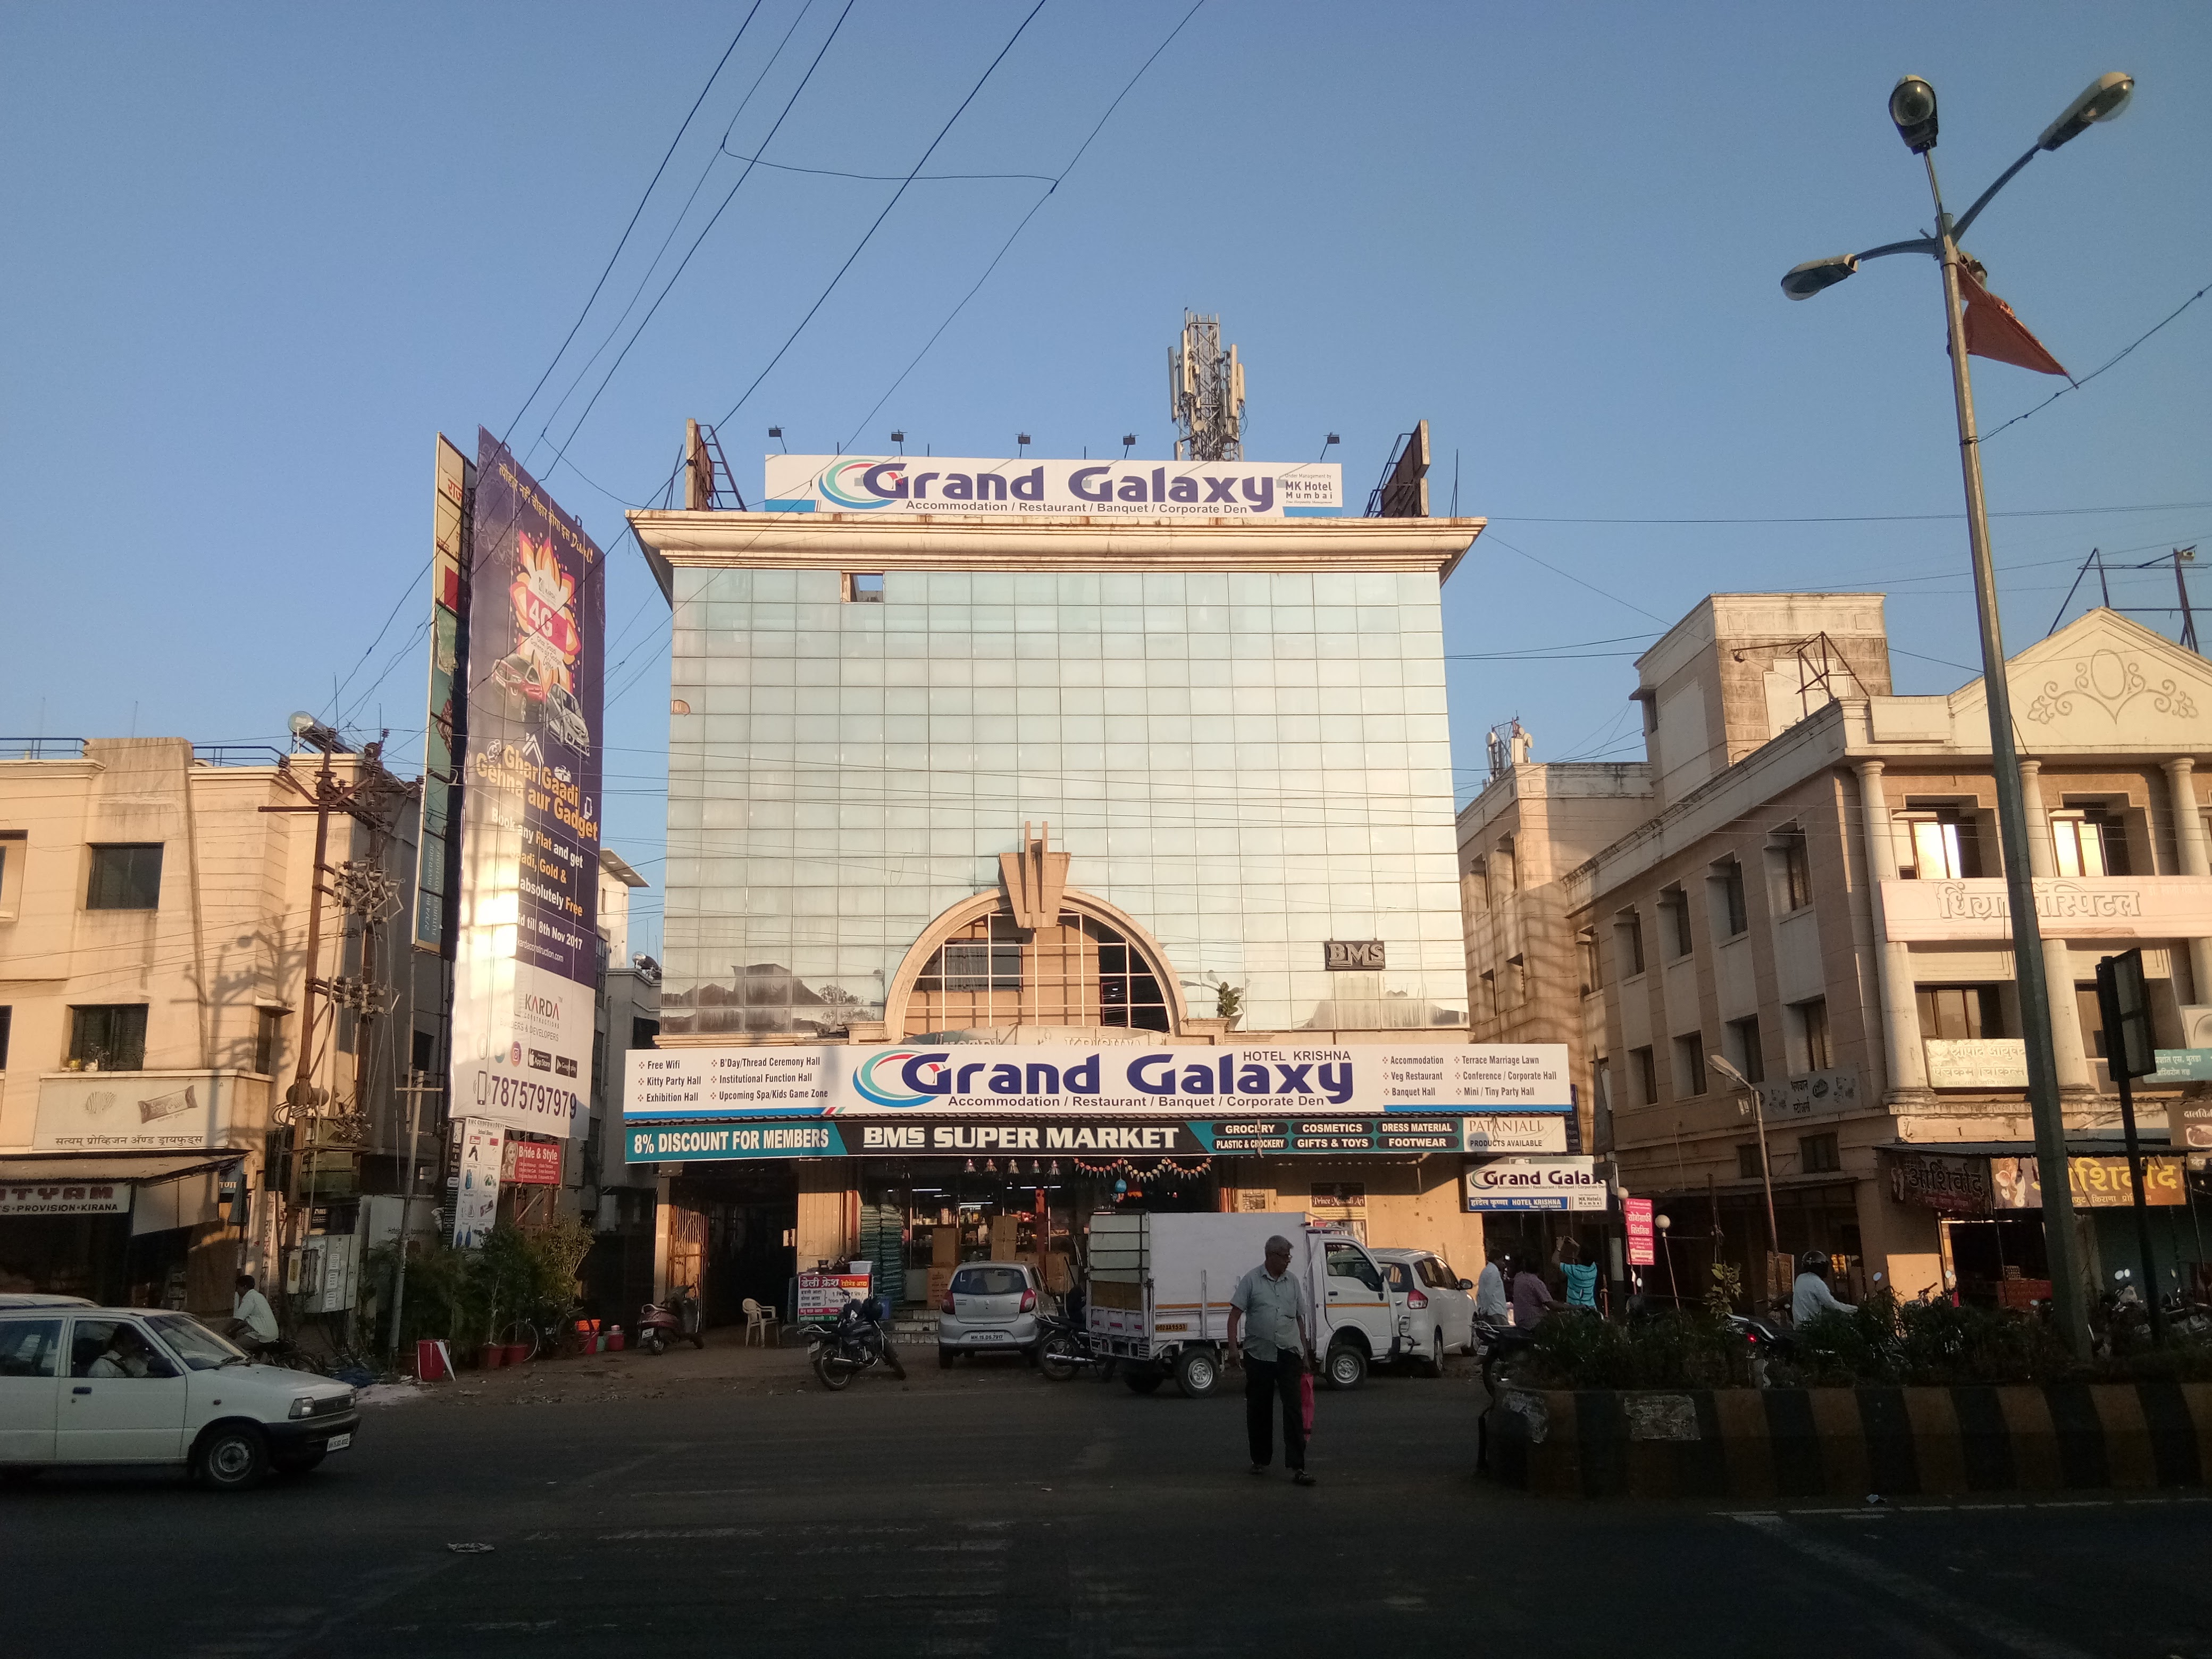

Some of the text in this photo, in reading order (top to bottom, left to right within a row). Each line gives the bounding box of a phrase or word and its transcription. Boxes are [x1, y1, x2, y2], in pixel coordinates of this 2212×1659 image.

[863, 463, 1273, 513] Grand Galaxy
[1286, 481, 1332, 491] MK Hotel
[906, 500, 1247, 516] Accommodation Restaurant Banquet Corporate Den
[529, 599, 553, 638] 4G
[505, 744, 580, 808] Ghar Gaadi
[476, 753, 598, 842] Gehna aur Gadget
[492, 807, 584, 868] Book any Flat and get
[539, 858, 558, 879] Gold
[560, 869, 567, 884] &
[520, 877, 583, 917] absolutely Free
[539, 920, 550, 937] 8th
[551, 926, 565, 943] Nov
[566, 933, 583, 951] 2017
[1329, 943, 1384, 966] BMS
[525, 993, 559, 1021] KARDA
[529, 1025, 559, 1042] DEVELOPERS
[769, 1058, 804, 1068] Ceremony
[807, 1057, 820, 1066] Hall
[1243, 1050, 1351, 1061] HOTEL KRISHNA
[1390, 1056, 1444, 1065] Accommodation
[1462, 1055, 1539, 1066] Terrace Marriage Lawn
[648, 1060, 680, 1070] Free Wifi
[647, 1076, 701, 1087] Kitty Party Hall
[719, 1073, 812, 1084] Institutional Function Hall
[901, 1053, 1353, 1104] Grand Galaxy
[1391, 1071, 1443, 1082] Veg Restaurant
[1463, 1071, 1556, 1082] Conference Corporate Hall
[491, 1075, 578, 1119] 7875797979
[647, 1092, 698, 1102] Exhibition Hall
[719, 1089, 828, 1101] Upcoming Spa/Kids Game Zone
[1392, 1087, 1436, 1097] Banquet Hall
[1464, 1087, 1534, 1097] Mini Tiny Party Hall
[948, 1095, 1324, 1109] Accommodation Restaurant Banquet Corporate Den
[1302, 1123, 1363, 1133] COSMETICS
[1382, 1124, 1410, 1132] DRESS
[1411, 1123, 1452, 1132] MATERIAL
[634, 1128, 829, 1154] 8% DISCOUNT FOR MEMBERS
[863, 1126, 1179, 1149] BMS SUPER MARKET
[1217, 1139, 1243, 1149] PLASTIC
[1244, 1139, 1250, 1149] &
[1297, 1138, 1328, 1148] GIFTS
[1331, 1138, 1339, 1147] &
[1341, 1138, 1369, 1147] TOYS
[1389, 1138, 1447, 1147] FOOTWEAR
[518, 1145, 558, 1163] Bride & Style
[1483, 1170, 1540, 1185] Grand
